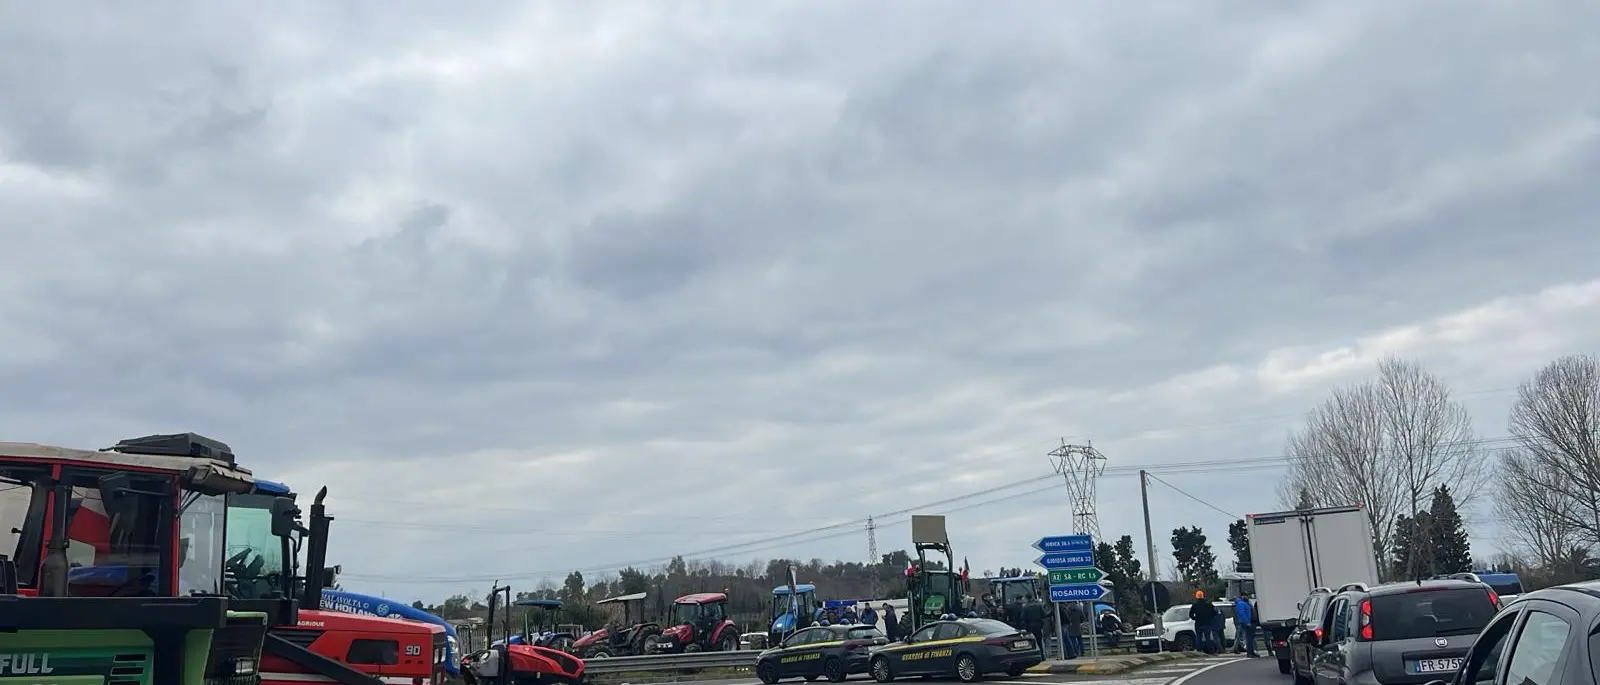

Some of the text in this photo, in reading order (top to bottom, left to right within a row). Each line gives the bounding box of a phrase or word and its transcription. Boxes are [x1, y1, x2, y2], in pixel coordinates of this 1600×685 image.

[1052, 589, 1089, 597] ROSARNO
[319, 600, 334, 609] EW
[405, 645, 420, 655] 90
[902, 652, 923, 661] GUARDIA
[930, 649, 953, 658] FINANZA
[1421, 660, 1434, 671] FR
